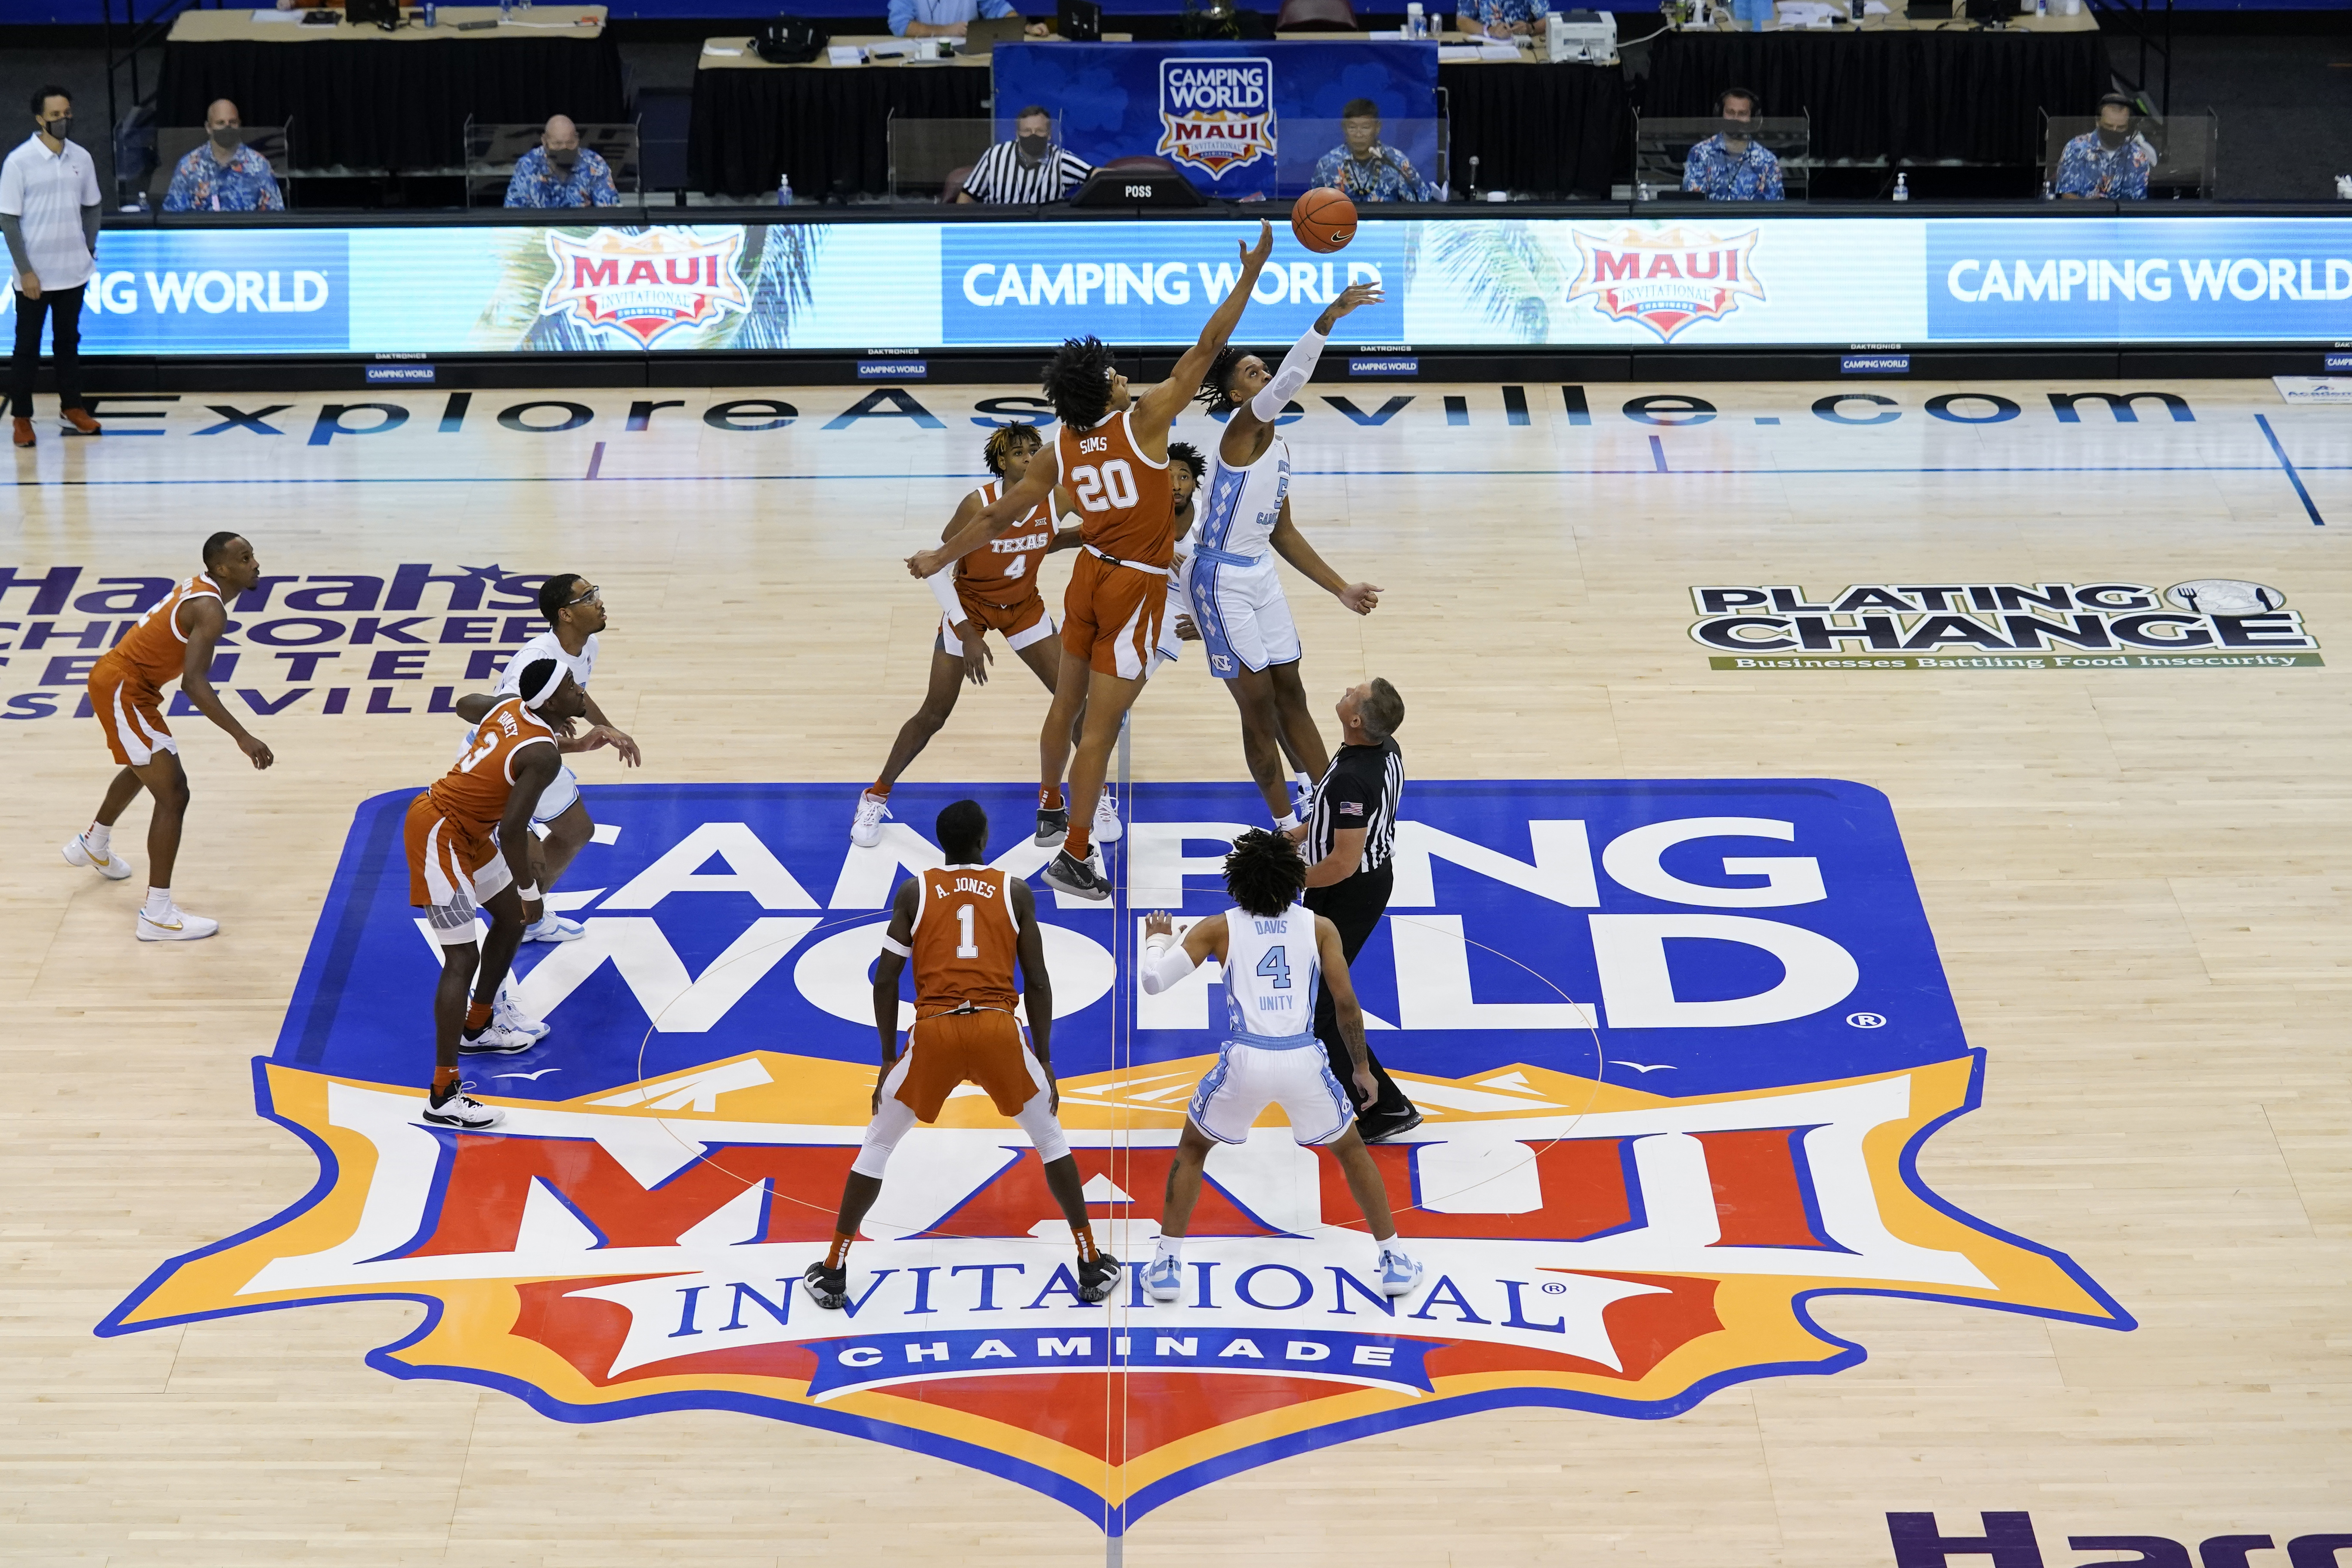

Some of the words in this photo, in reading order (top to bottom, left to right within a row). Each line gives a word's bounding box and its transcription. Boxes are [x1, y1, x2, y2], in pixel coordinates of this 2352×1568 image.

[1169, 68, 1263, 87] CAMPING
[1169, 86, 1264, 108] WORLD
[1175, 122, 1257, 141] MAUI
[1125, 185, 1152, 198] POSS
[572, 254, 720, 289] MAUI
[1591, 249, 1740, 284] MAUI
[145, 270, 329, 314] WORLD
[962, 262, 1190, 306] CAMPING
[1198, 261, 1382, 305] WORLD
[1947, 258, 2172, 302] CAMPING
[600, 291, 690, 309] INVITATIONAL
[368, 370, 404, 378] CAMPING
[404, 369, 433, 377] WORLD
[860, 366, 896, 374] CAMPING
[896, 365, 925, 374] WORLD
[1352, 362, 1387, 371] CAMPING
[1843, 360, 1879, 368] CAMPING
[1879, 359, 1908, 368] WORLD
[1079, 436, 1108, 455] SIMS
[1071, 458, 1140, 513] 20
[1274, 476, 1288, 509] 5
[990, 532, 1049, 554] TEXAS
[1004, 554, 1026, 580] 4
[1699, 585, 2156, 613] PLATING
[1698, 612, 2312, 650] CHANGE
[1735, 656, 1907, 668] Businesses
[1917, 656, 2046, 670] Battling
[2055, 655, 2129, 667] Food
[2137, 654, 2297, 668] Insecurity
[497, 710, 519, 739] RAMEY
[460, 731, 499, 773] 3
[935, 884, 950, 899] A.
[953, 877, 997, 899] JONES
[956, 904, 978, 959] 1
[1254, 920, 1288, 935] DAVIS
[1256, 946, 1291, 989] 4
[1259, 995, 1293, 1011] UNITY
[353, 1122, 1863, 1265] MAUI
[838, 1336, 1395, 1368] CHAMINADE
